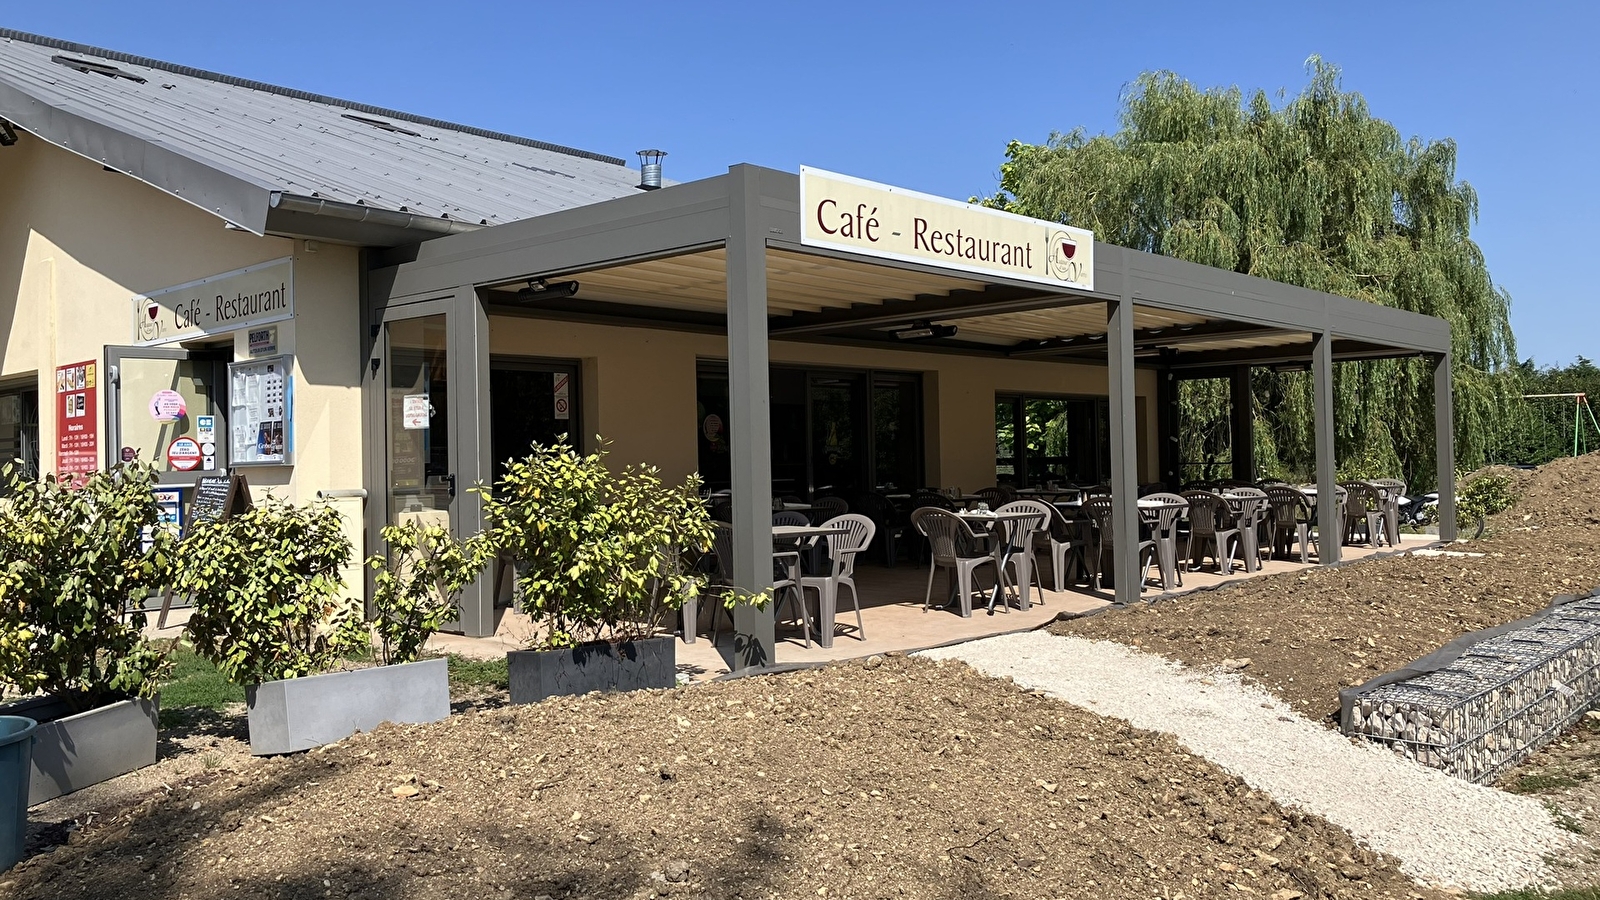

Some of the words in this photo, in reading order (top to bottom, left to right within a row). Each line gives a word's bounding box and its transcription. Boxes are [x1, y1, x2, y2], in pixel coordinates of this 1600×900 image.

[817, 199, 880, 242] Café
[914, 217, 1032, 269] Restaurant
[174, 298, 201, 330] Café
[215, 282, 287, 322] Restaurant
[249, 330, 270, 343] PELFORTH
